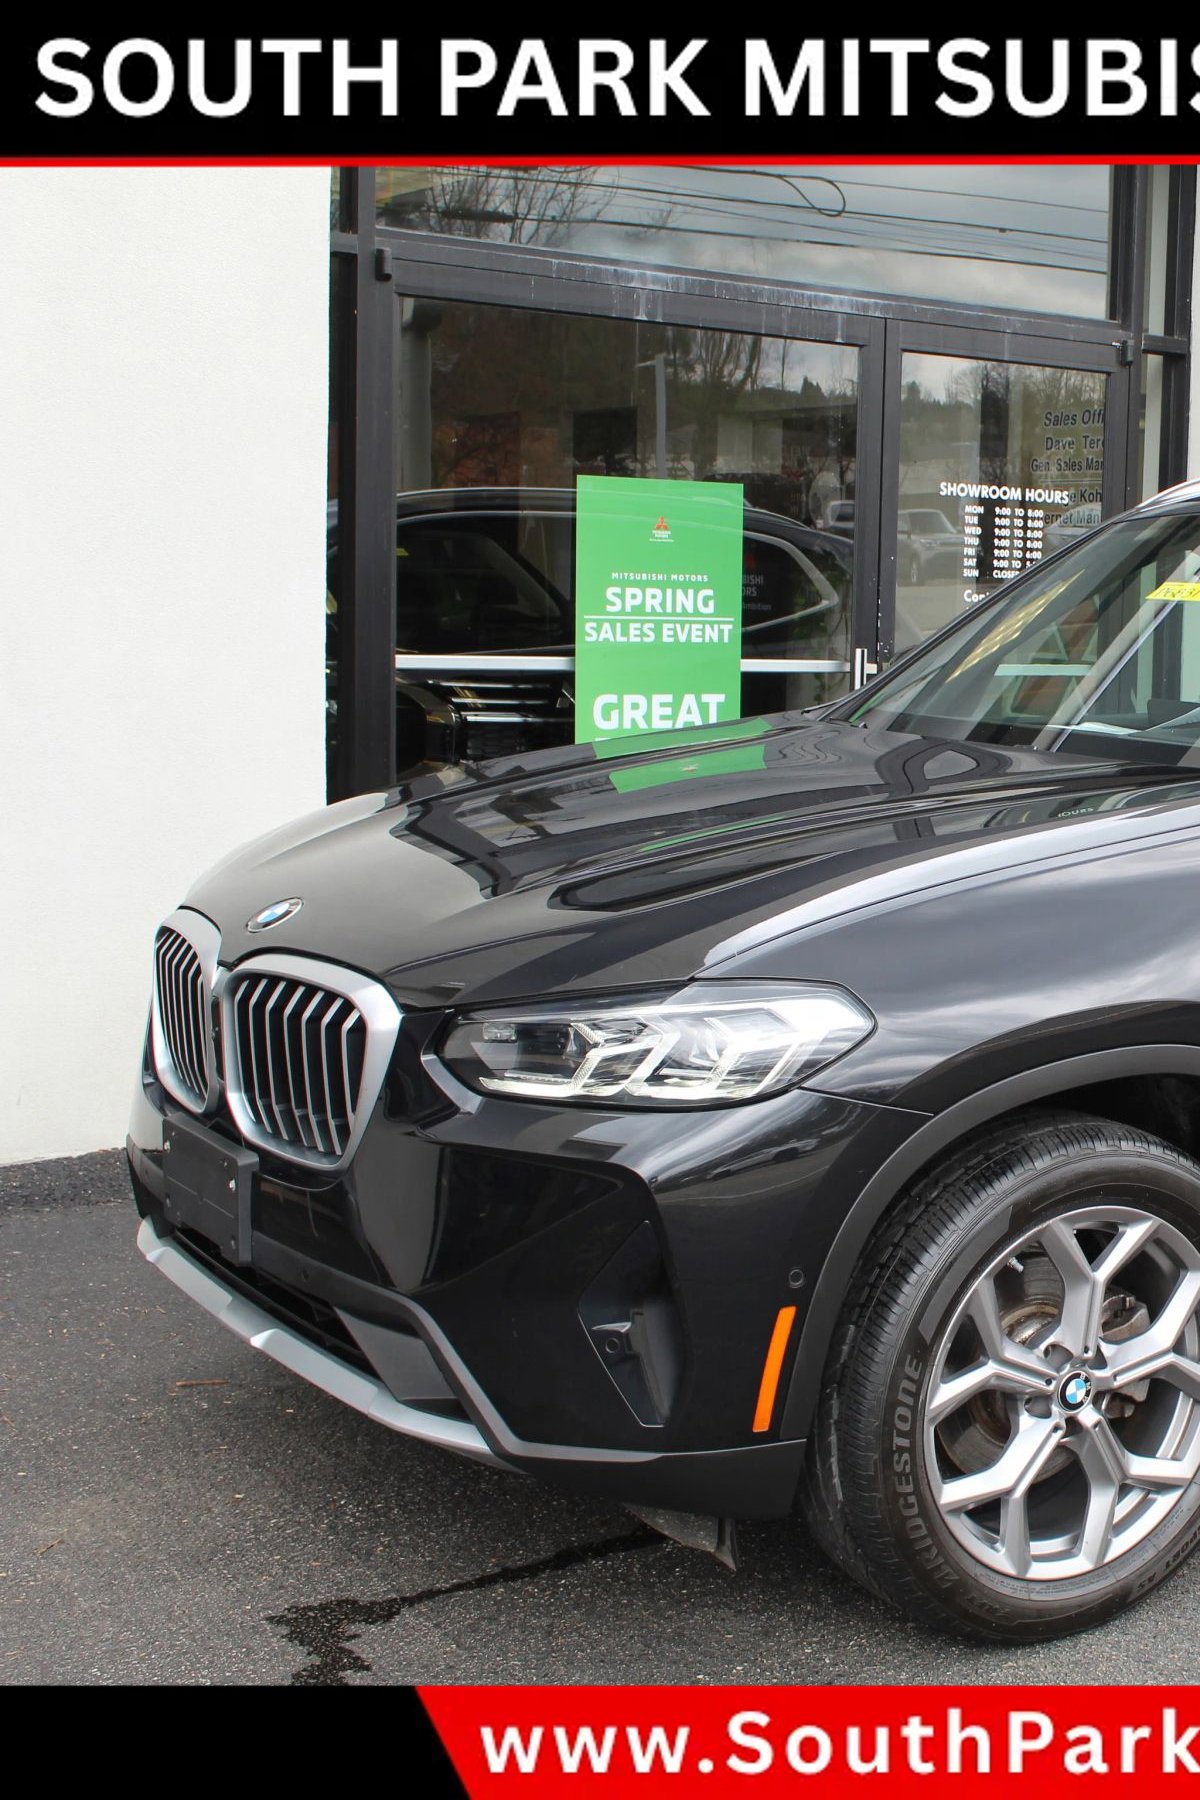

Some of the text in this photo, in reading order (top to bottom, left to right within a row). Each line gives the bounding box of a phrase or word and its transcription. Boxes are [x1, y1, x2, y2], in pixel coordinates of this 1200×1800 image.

[1044, 411, 1077, 427] Sales
[1045, 436, 1075, 451] Dave
[1056, 457, 1083, 472] Sales
[940, 481, 1022, 501] SHOWROOM
[1025, 488, 1070, 505] HOURS
[964, 505, 1044, 518] MON 9:00 TO 8:00
[964, 515, 1043, 529] TUE 9:00 TO 8:00
[964, 526, 1043, 539] WED 9:00 TO 8:00
[964, 537, 1043, 549] THU 9:00 TO 8:00
[963, 547, 976, 556] FRI
[993, 548, 1010, 558] 9:00
[1012, 550, 1023, 559] TO
[963, 558, 977, 567] SAT
[992, 559, 1009, 568] 9:00
[1011, 560, 1022, 569] TO
[611, 572, 709, 583] MITSUBISHI MOTORS
[963, 568, 979, 578] SUN
[605, 587, 715, 614] SPRING
[584, 622, 733, 643] SALES EVENT
[592, 693, 726, 730] GREAT
[893, 1354, 960, 1588] BRIDGESTONE
